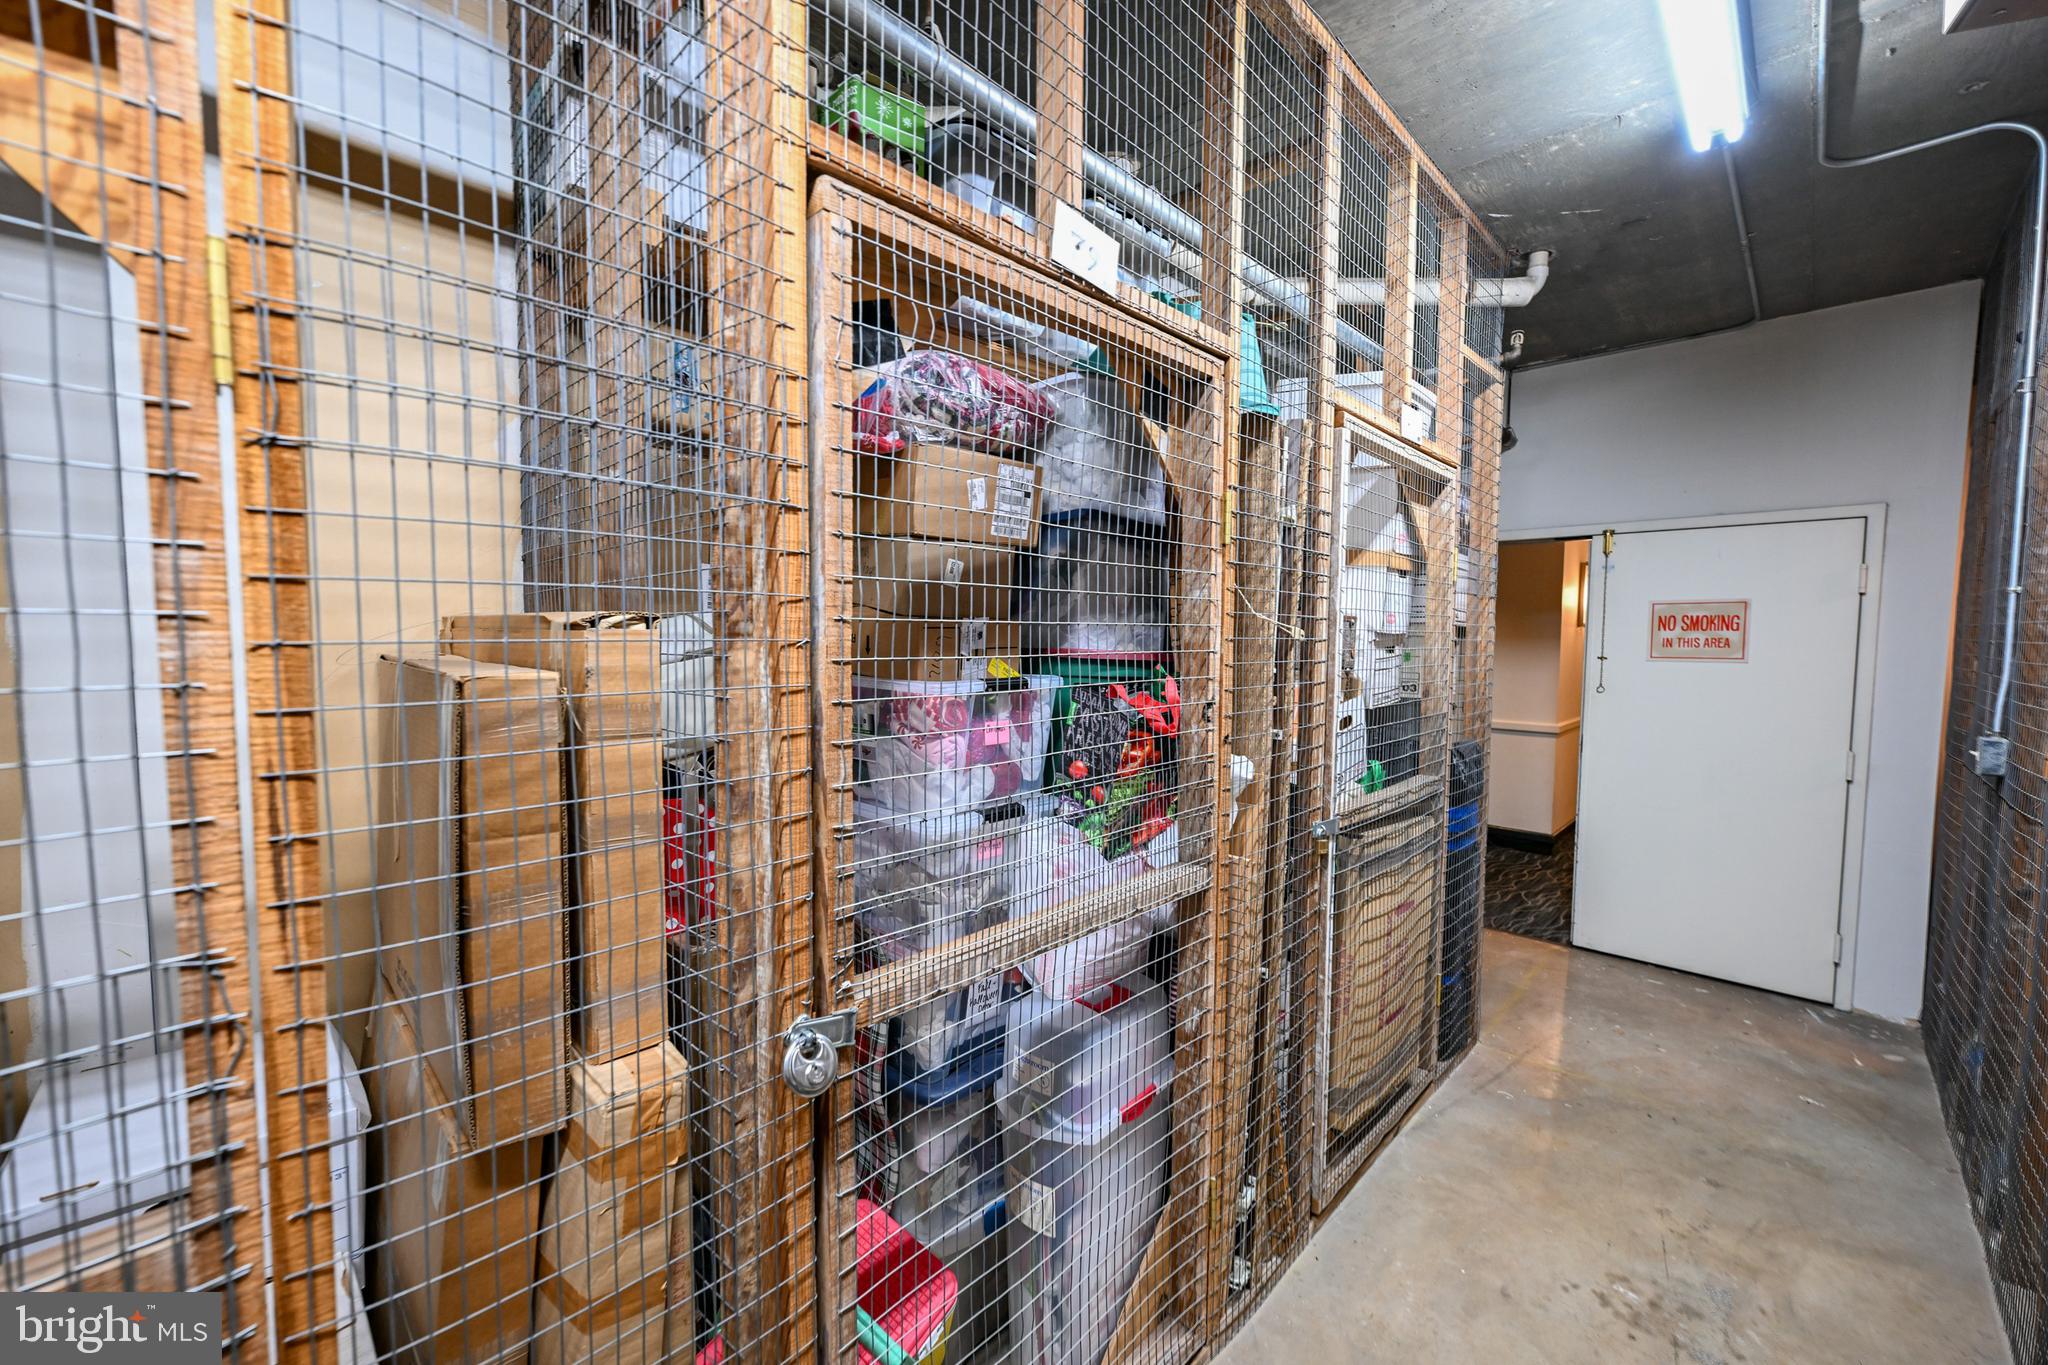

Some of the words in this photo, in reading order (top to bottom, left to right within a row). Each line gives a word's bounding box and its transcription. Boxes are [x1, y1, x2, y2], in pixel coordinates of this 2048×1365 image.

[1658, 615, 1676, 631] NO
[1681, 615, 1740, 631] SMOKING
[1662, 637, 1673, 648] IN
[1676, 637, 1700, 648] THIS
[1703, 637, 1731, 648] AREA
